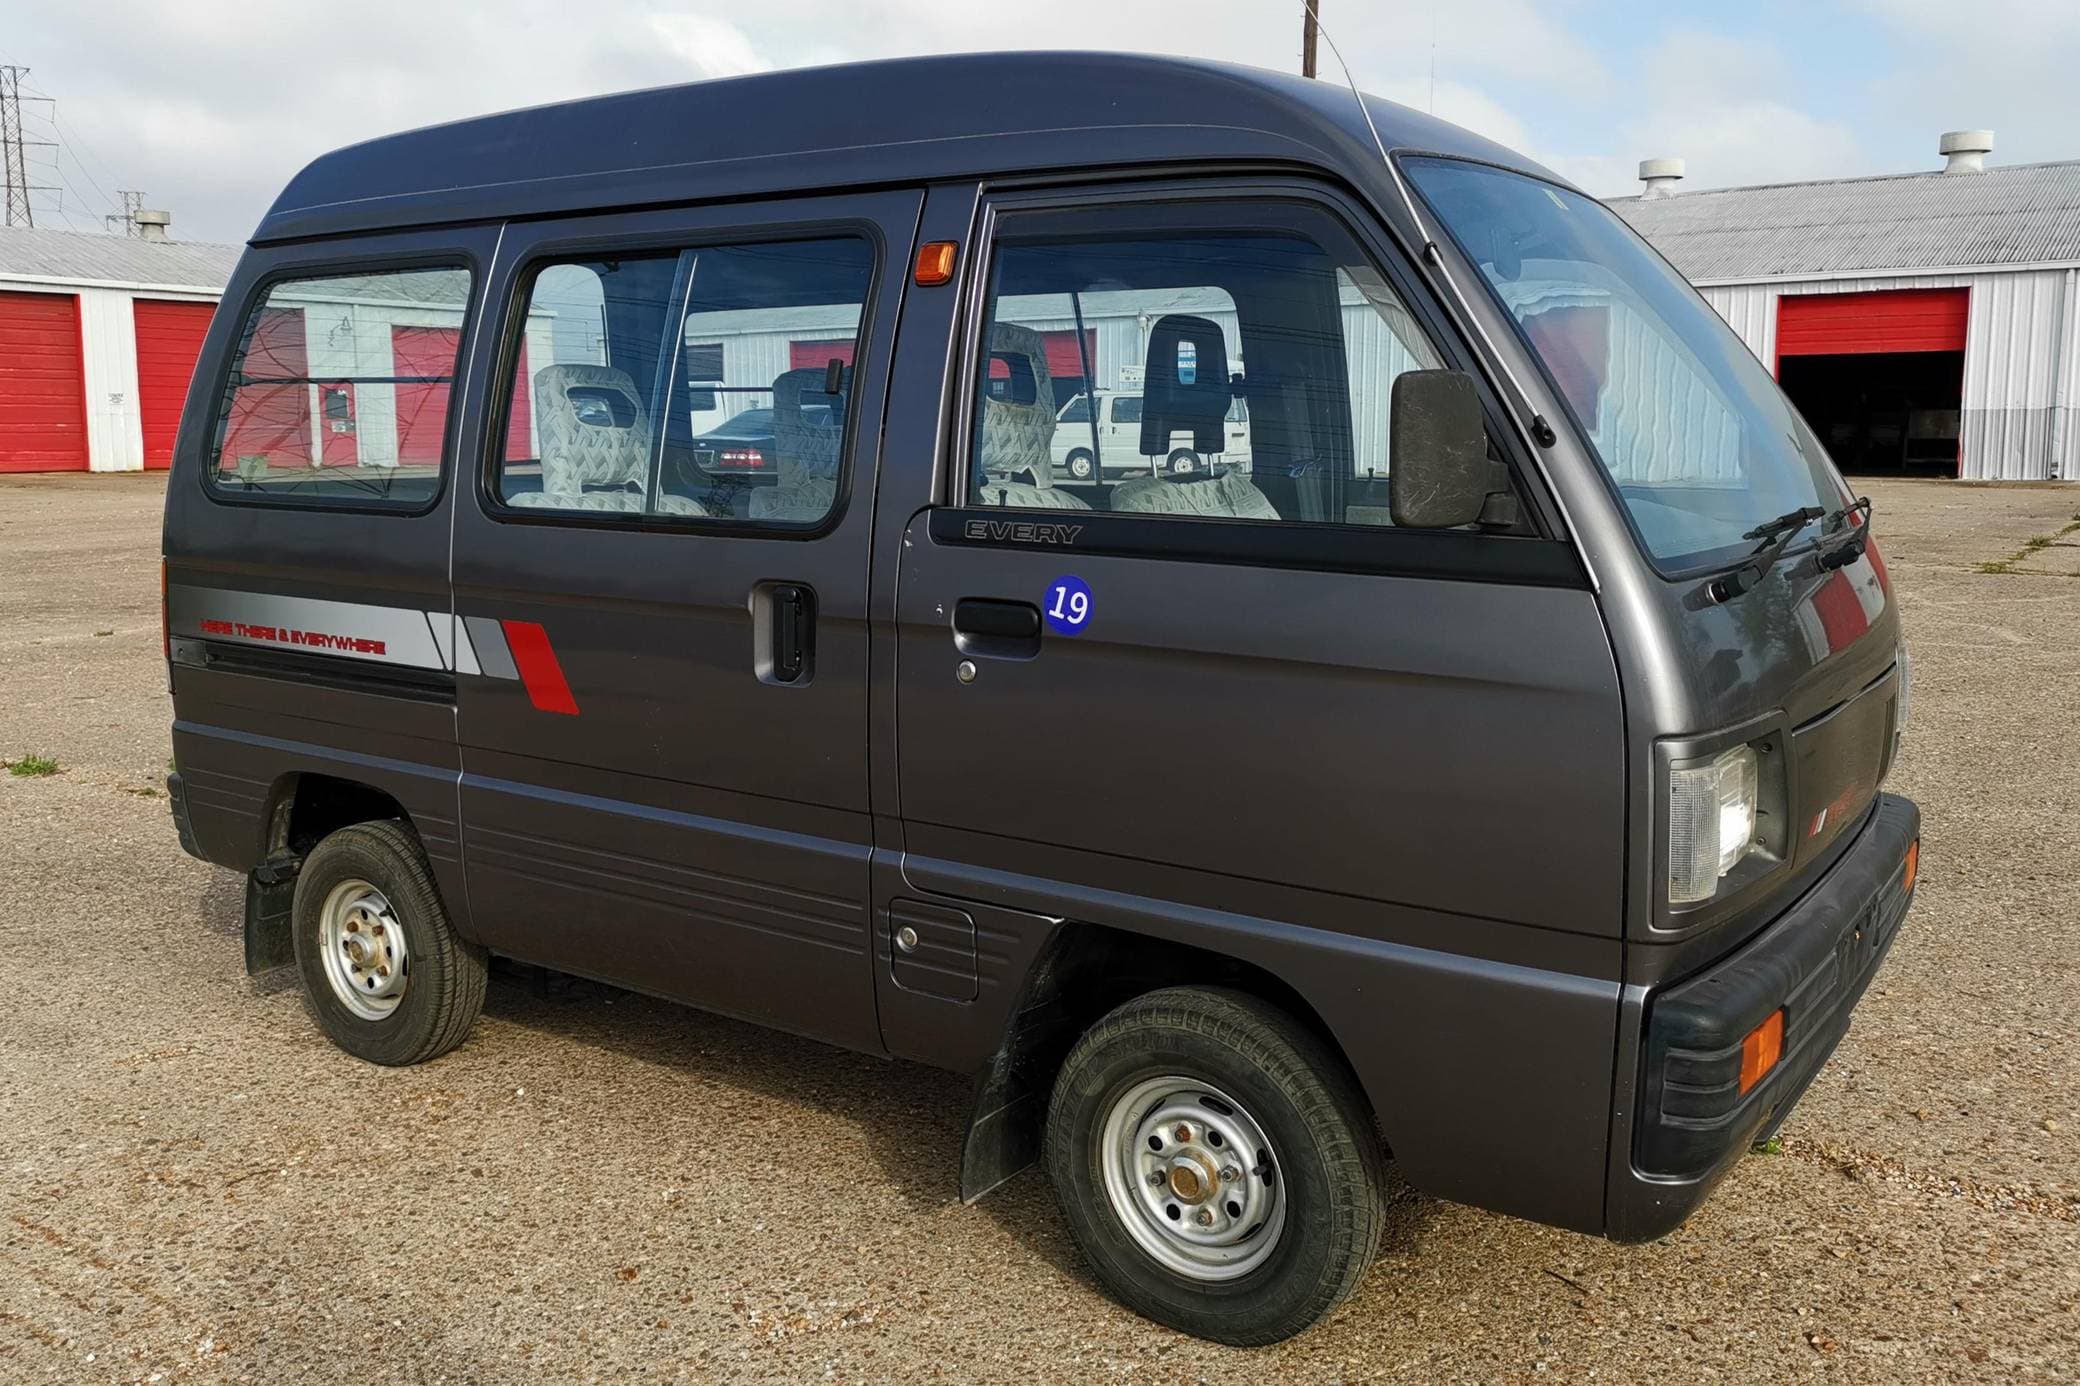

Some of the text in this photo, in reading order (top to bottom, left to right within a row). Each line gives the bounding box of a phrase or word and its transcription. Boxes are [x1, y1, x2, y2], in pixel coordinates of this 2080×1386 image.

[965, 519, 1083, 544] EVERY
[1048, 586, 1088, 624] 19
[200, 619, 386, 655] HERE THERE & EVERYWHERE
